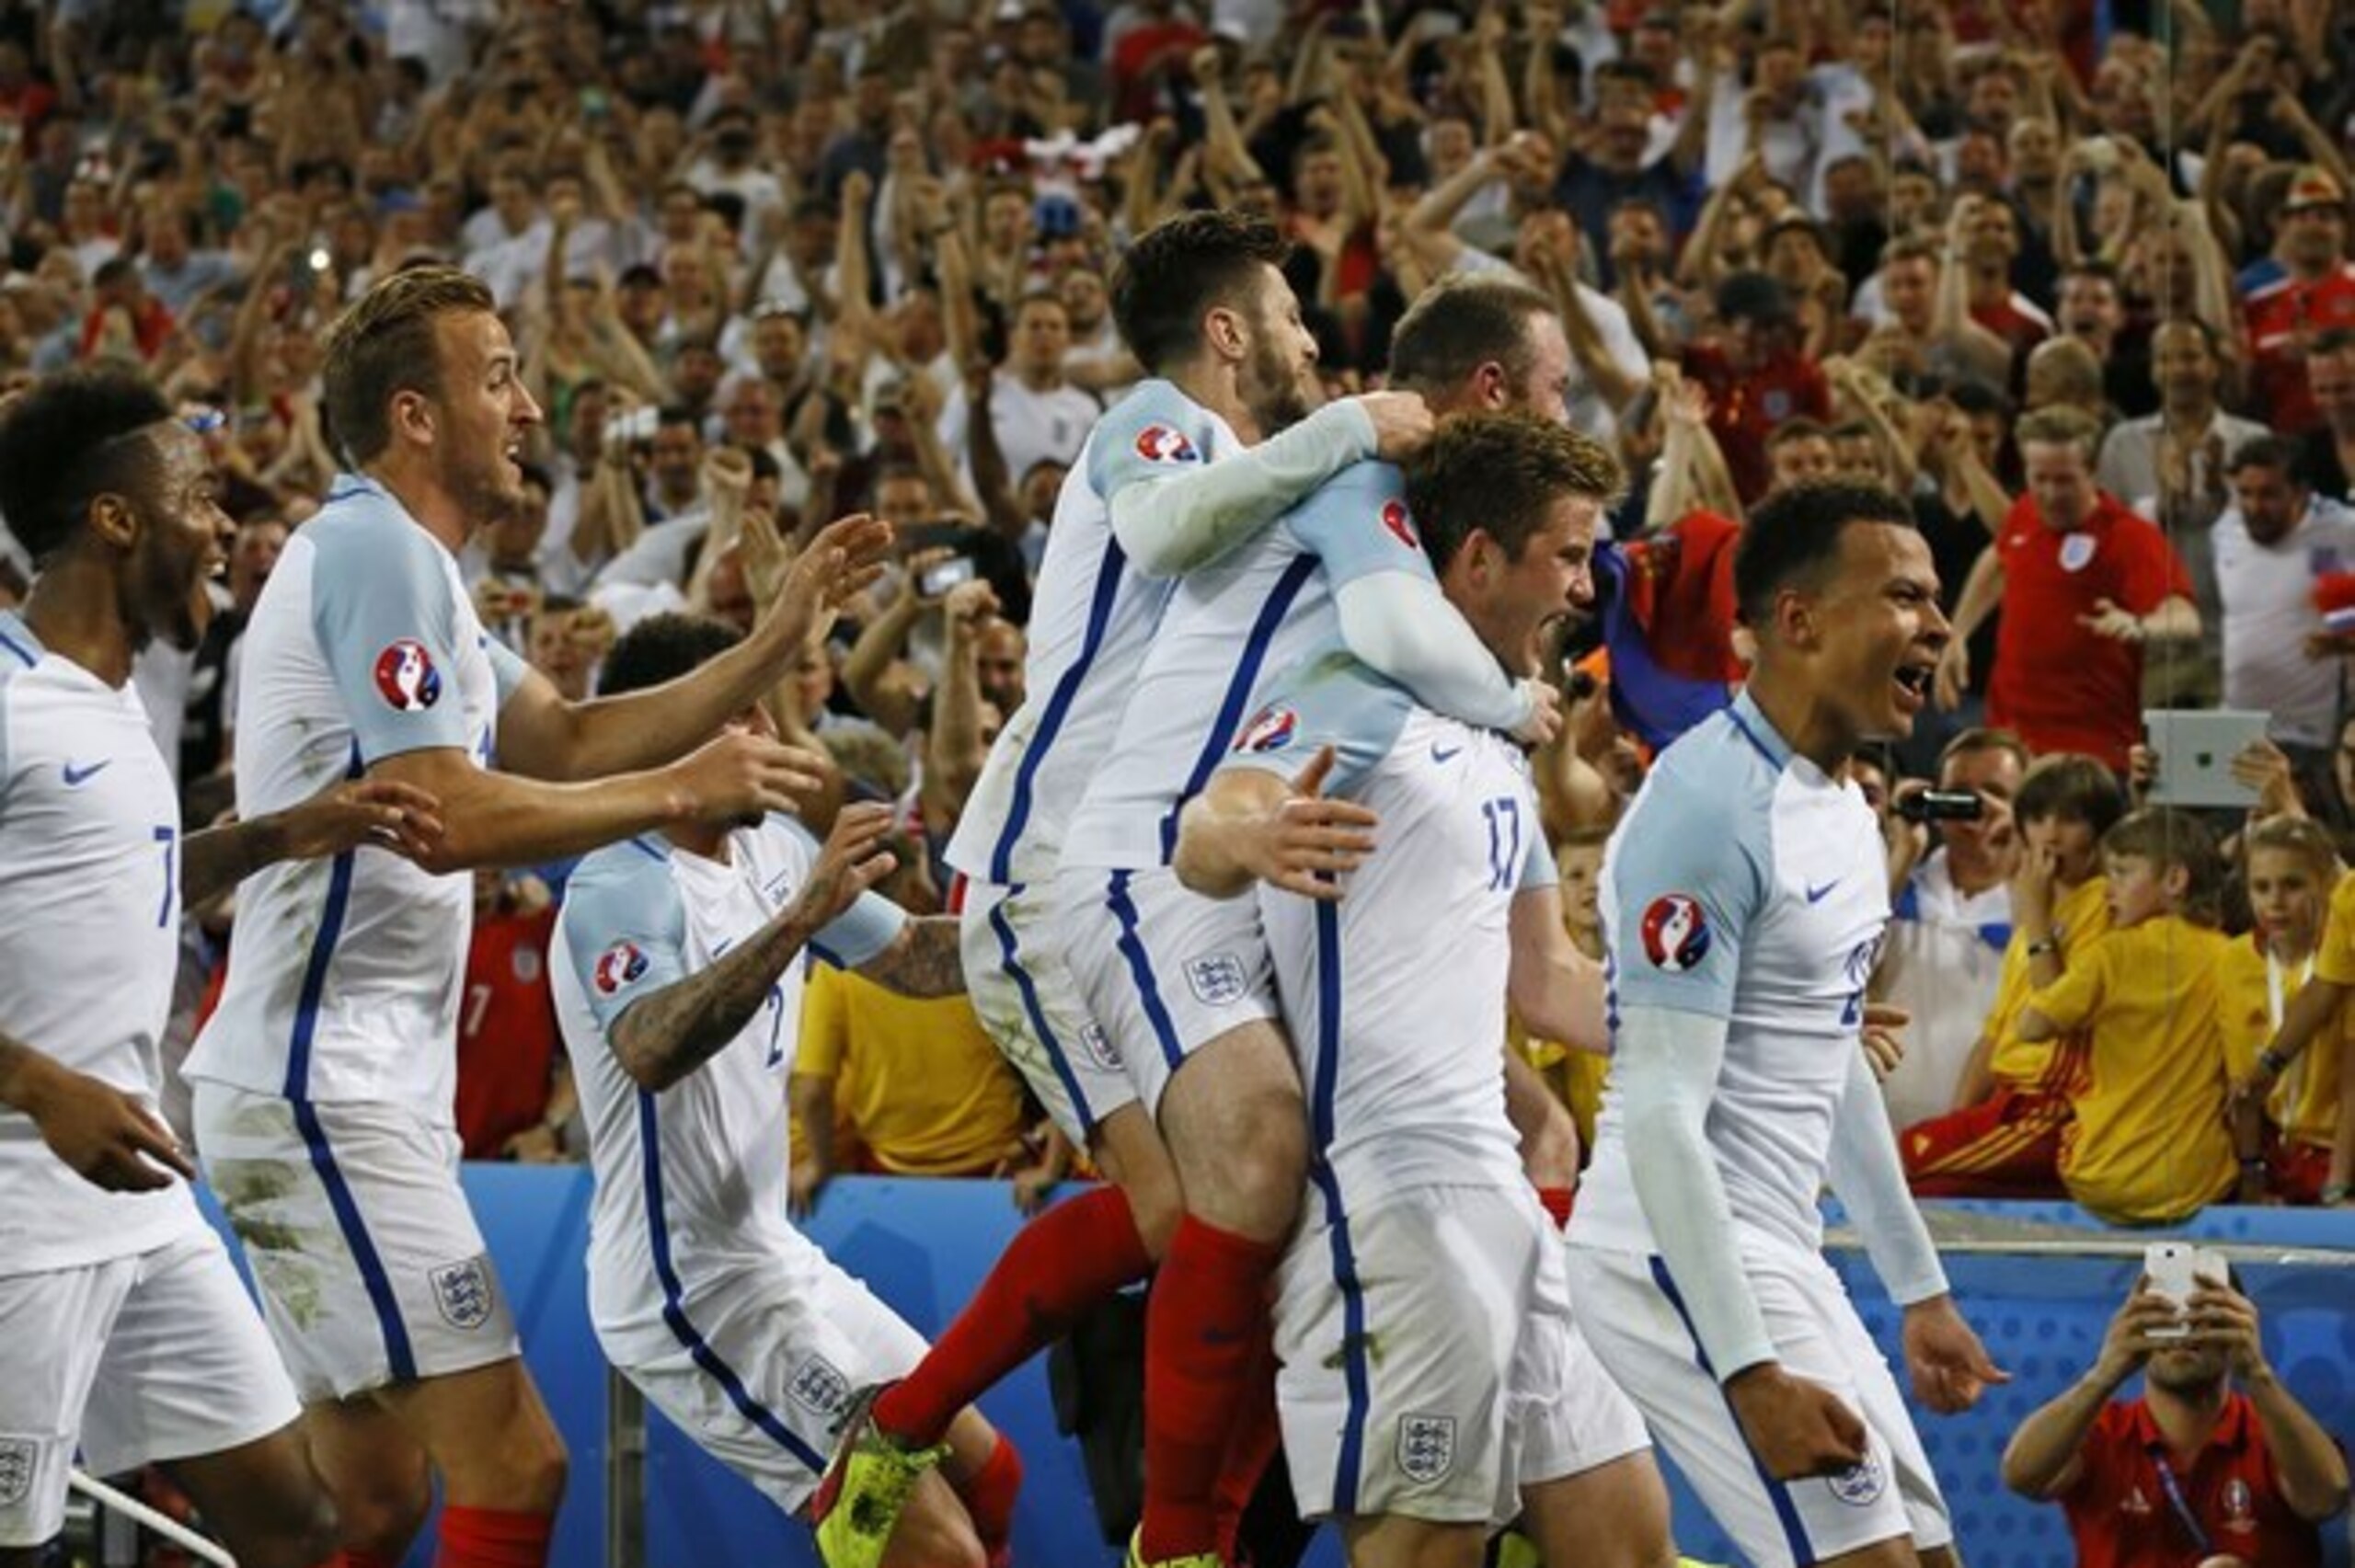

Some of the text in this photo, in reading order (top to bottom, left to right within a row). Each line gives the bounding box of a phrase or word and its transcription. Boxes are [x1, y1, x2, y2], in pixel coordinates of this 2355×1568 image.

[154, 826, 175, 928] 7
[1481, 796, 1519, 892] 17
[466, 985, 491, 1036] 7
[766, 982, 784, 1068] 2
